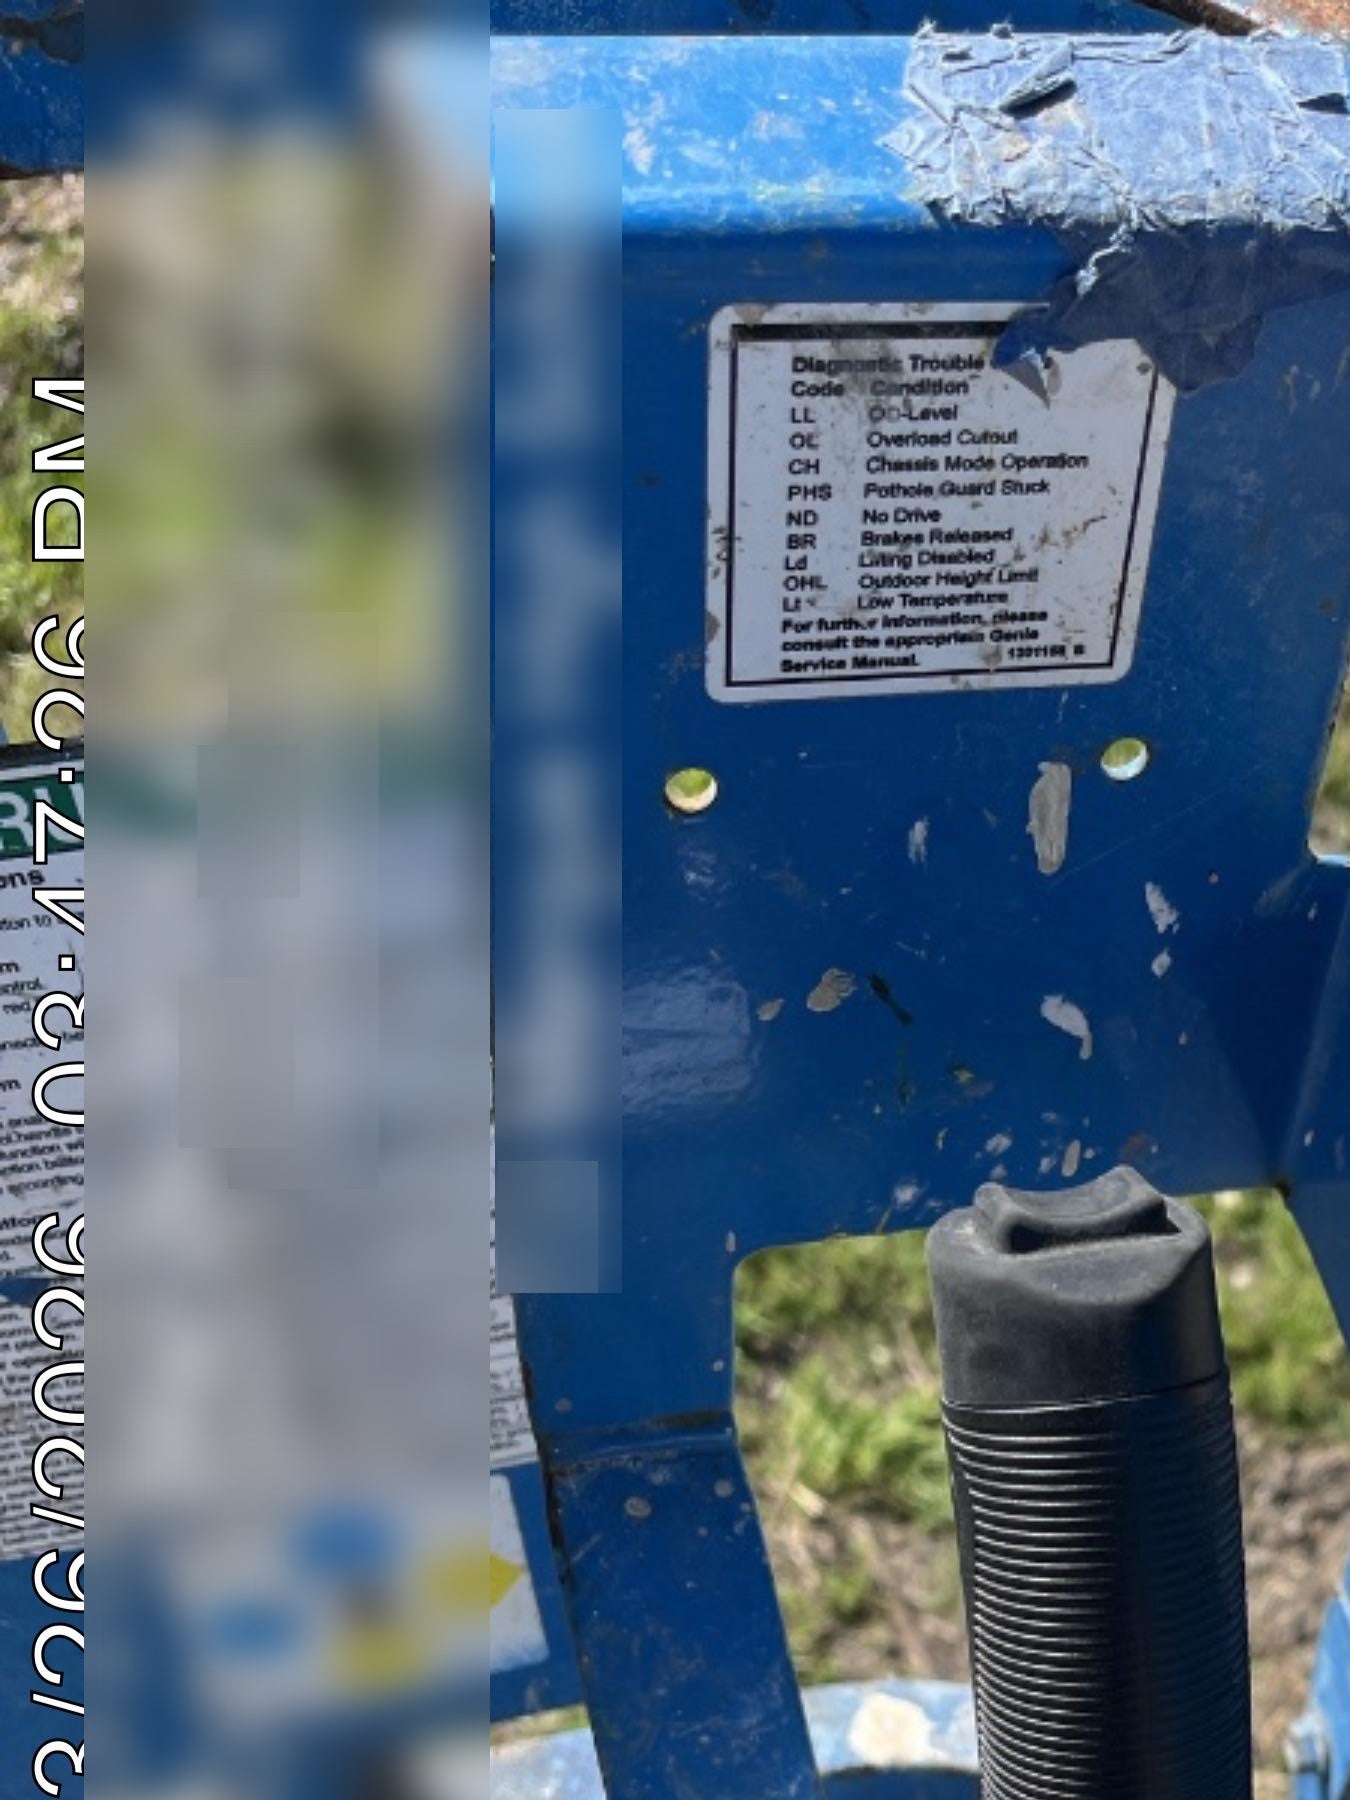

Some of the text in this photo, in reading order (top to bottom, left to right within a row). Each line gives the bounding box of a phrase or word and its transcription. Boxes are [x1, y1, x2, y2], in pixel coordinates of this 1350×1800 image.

[909, 354, 984, 373] Trouble
[791, 378, 970, 397] Code Condition
[791, 407, 816, 424] LL
[866, 431, 952, 448] Overload
[956, 428, 1018, 445] Cutout
[788, 452, 1089, 475] CH Chassis Mode Operation
[787, 477, 1050, 501] PHS Pothole Guard Stuck
[785, 507, 943, 527] ND No Drive
[786, 528, 1015, 550] BR Brakes Released
[784, 555, 808, 571] Ld
[917, 549, 997, 566] Disabled
[858, 573, 931, 590] Outdoor
[935, 569, 994, 588] Height
[998, 567, 1040, 583] Limit
[857, 595, 895, 610] Low
[899, 592, 1009, 610] Temperature
[782, 618, 813, 634] For
[992, 610, 1049, 625] please
[782, 636, 849, 652] consult
[853, 634, 881, 649] the
[990, 626, 1040, 643] Genie
[780, 652, 920, 673] Service Manual.
